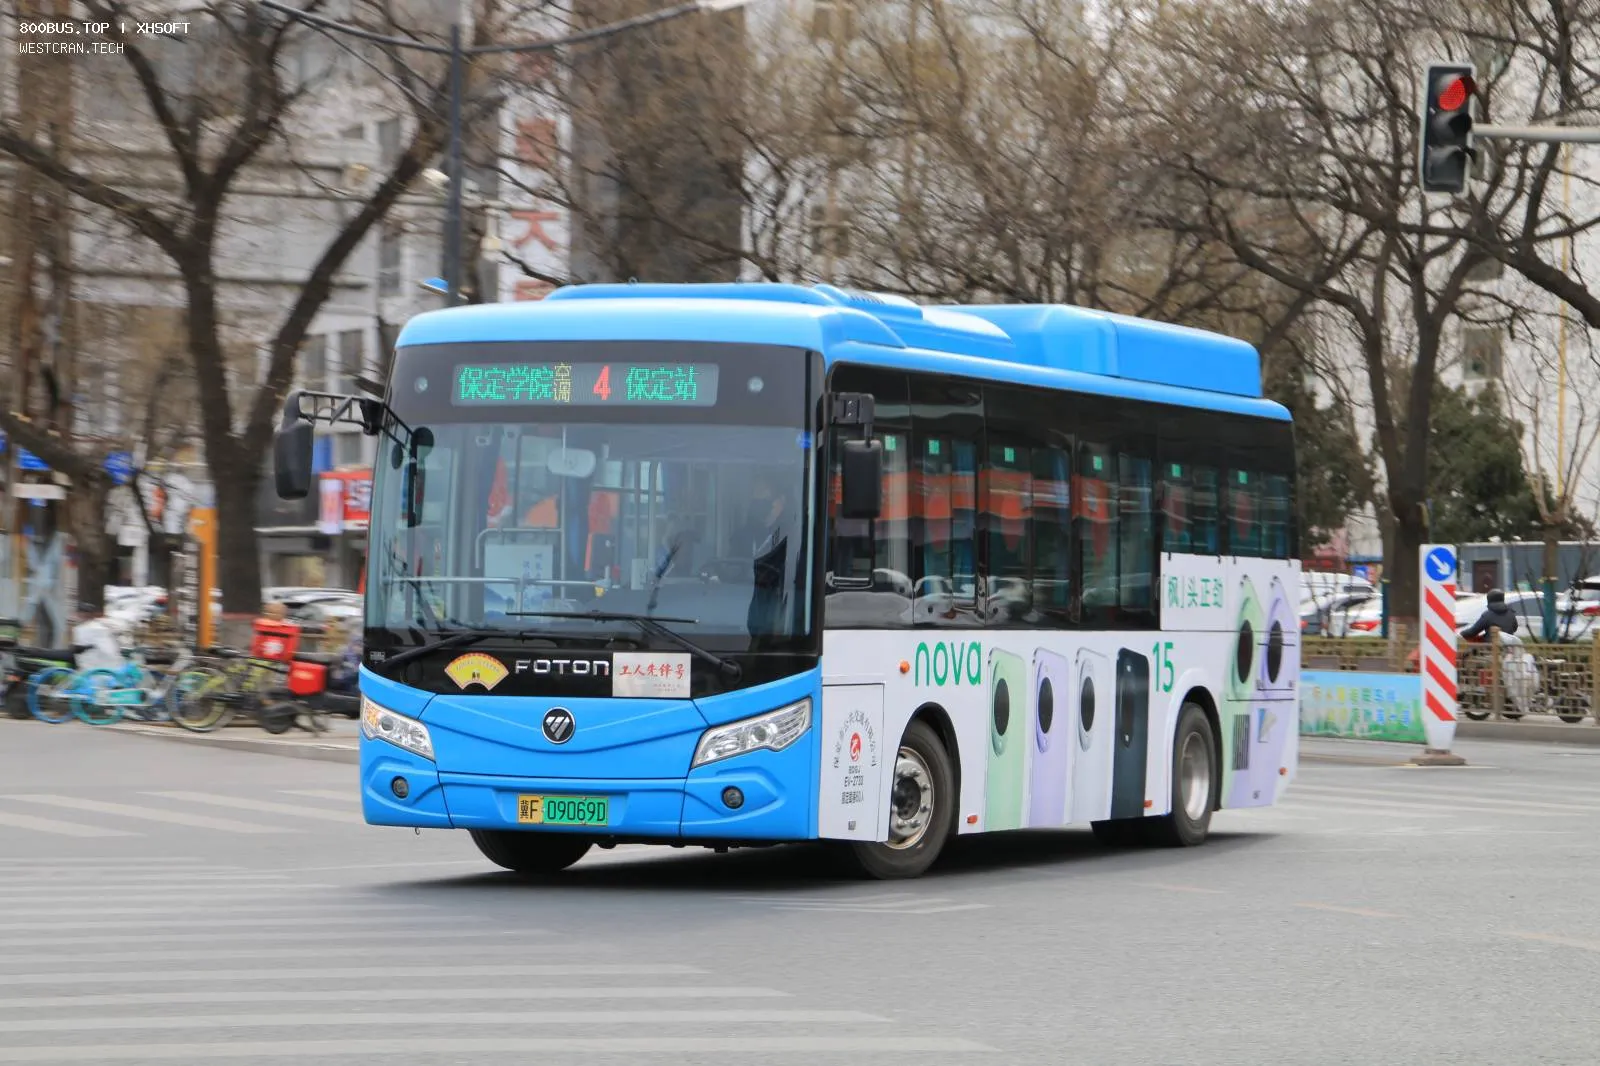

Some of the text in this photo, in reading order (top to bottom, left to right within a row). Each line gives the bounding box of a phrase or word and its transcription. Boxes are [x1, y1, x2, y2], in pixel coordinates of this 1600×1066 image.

[459, 364, 701, 401] 保定学院 4 保定站
[514, 659, 610, 676] FOTON
[619, 663, 687, 680] 工人先锋号
[915, 641, 982, 686] nova
[1152, 641, 1174, 692] 15
[547, 800, 606, 822] 09069D
